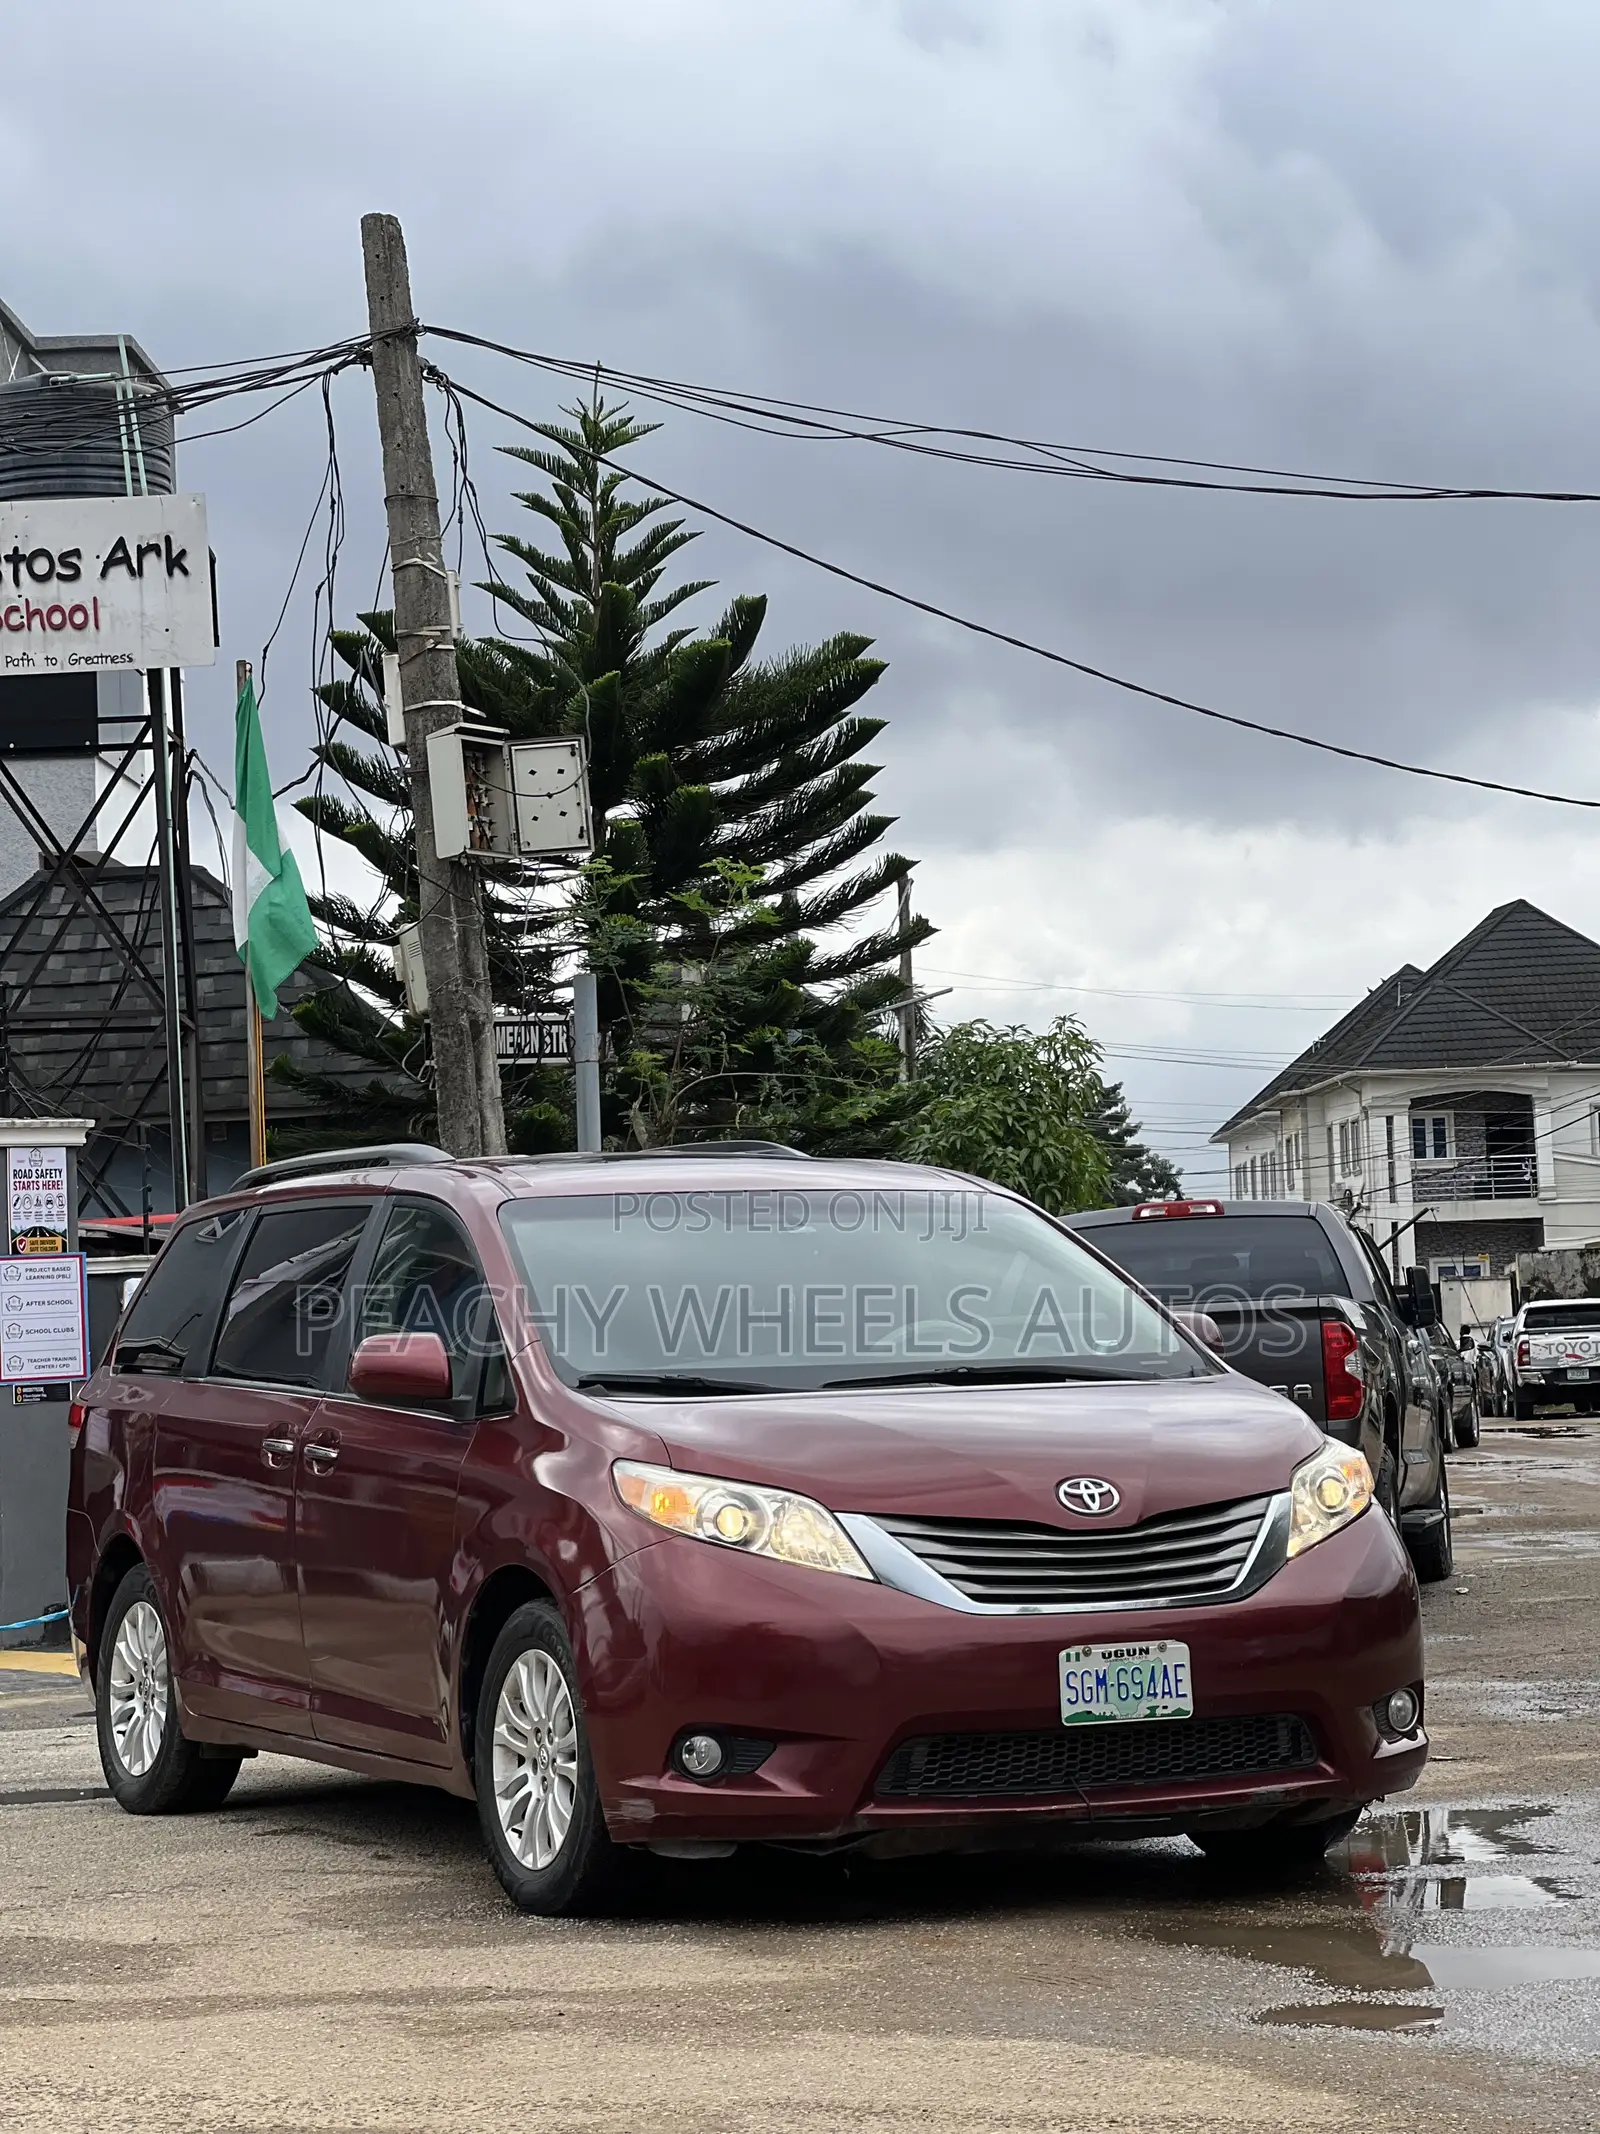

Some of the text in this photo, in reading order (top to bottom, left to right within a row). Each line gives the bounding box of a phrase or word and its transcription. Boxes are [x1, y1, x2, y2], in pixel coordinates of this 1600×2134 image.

[0, 534, 189, 588] tos Ark
[5, 652, 134, 668] Path to Greatness
[13, 1168, 63, 1179] ROAD SAFETY
[13, 1179, 64, 1191] STARTS HERE!
[1065, 1663, 1188, 1705] SGM-694AE
